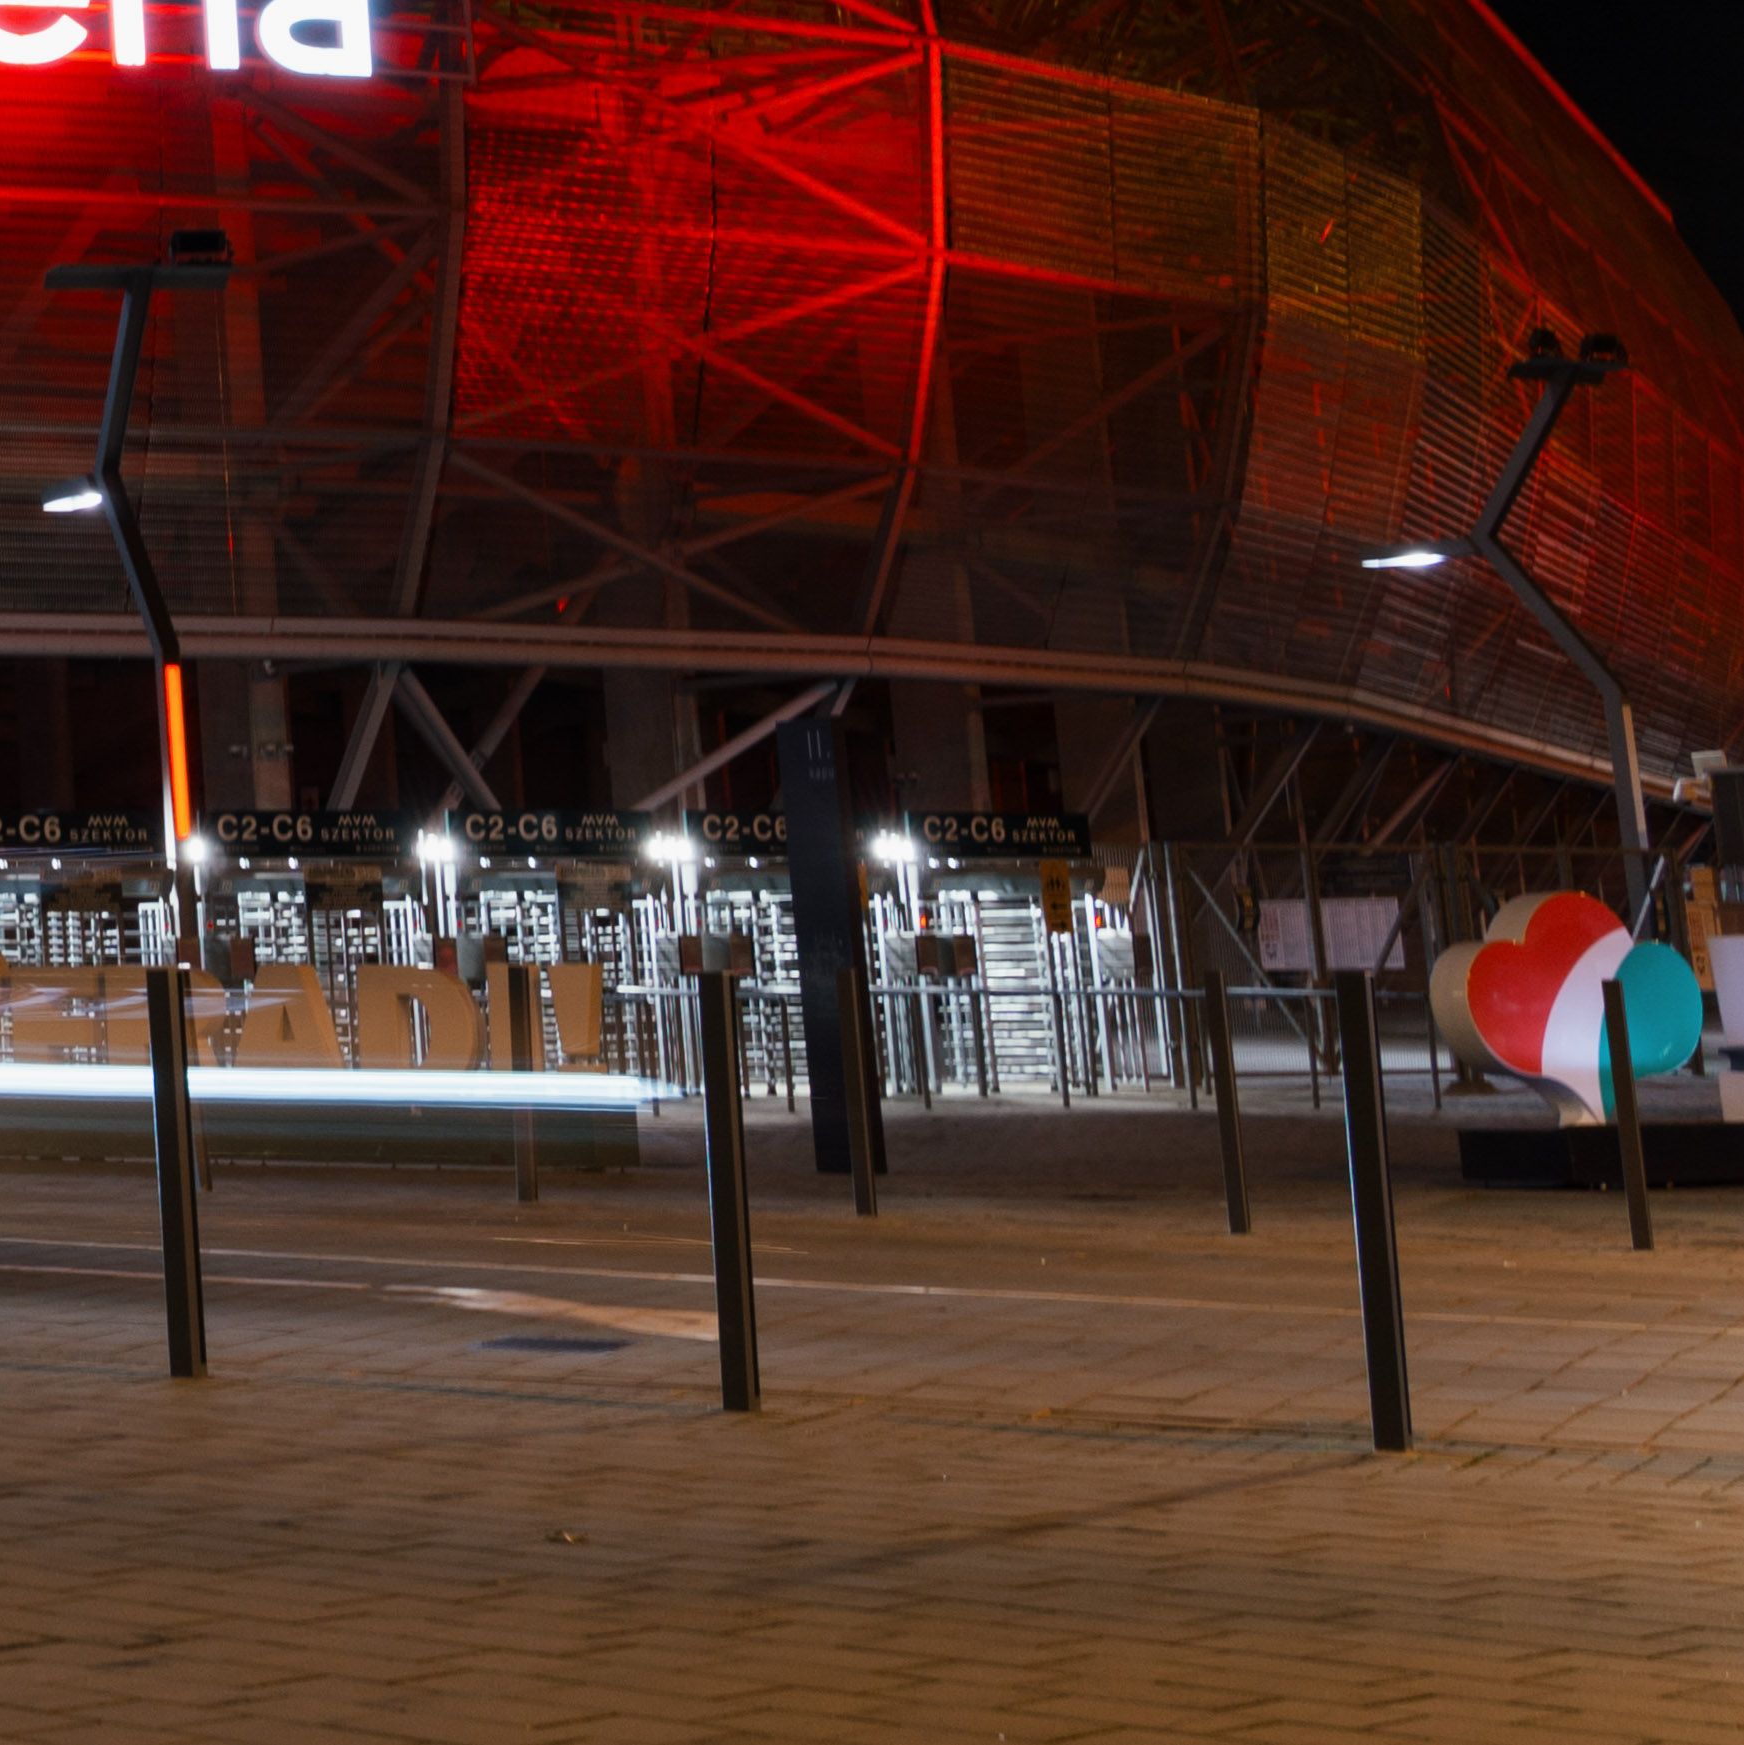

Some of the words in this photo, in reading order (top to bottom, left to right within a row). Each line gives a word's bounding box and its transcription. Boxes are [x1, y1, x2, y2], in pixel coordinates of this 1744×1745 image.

[87, 815, 129, 827] MVM
[337, 813, 377, 826] MVM
[580, 813, 620, 826] MVM
[1026, 815, 1060, 828] MVM
[217, 813, 314, 842] C2-C6
[321, 826, 395, 841] SZEKTOR
[465, 813, 558, 842] C2-C6
[564, 826, 637, 841] SZEKTOR
[923, 815, 1006, 843] C2-C6
[69, 828, 148, 843] SZEKTOR
[1011, 829, 1077, 844] SZEKTOR
